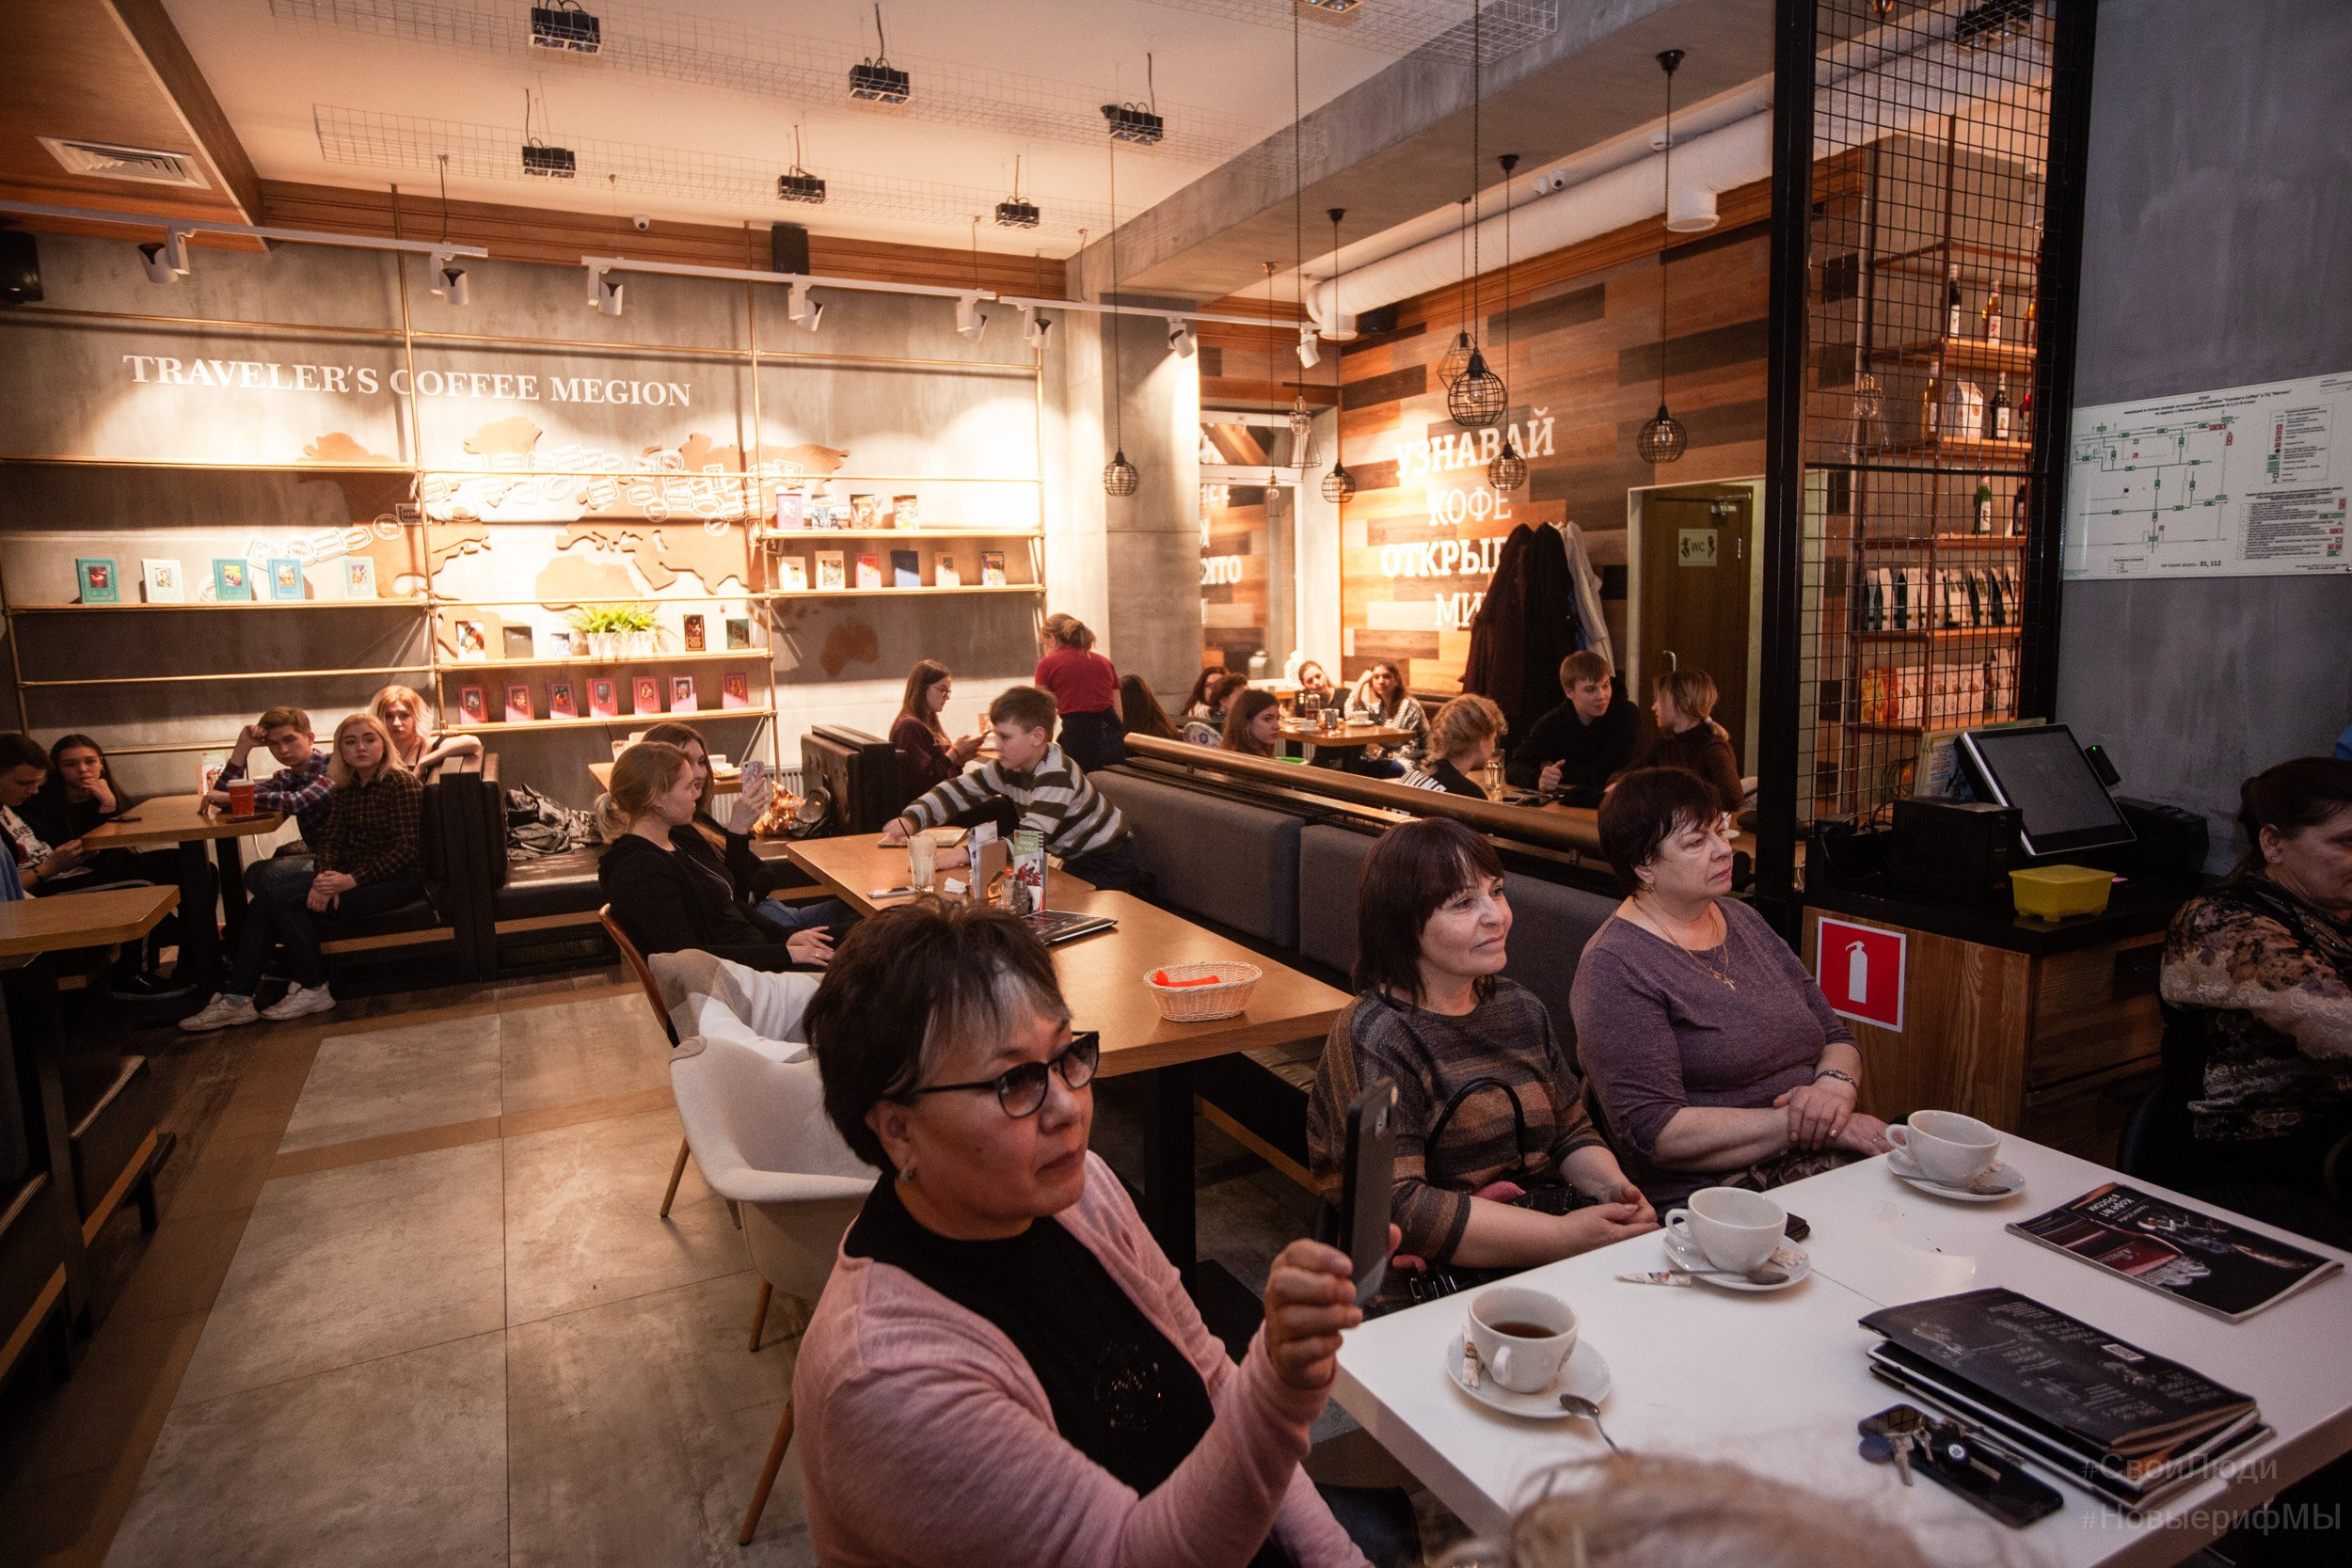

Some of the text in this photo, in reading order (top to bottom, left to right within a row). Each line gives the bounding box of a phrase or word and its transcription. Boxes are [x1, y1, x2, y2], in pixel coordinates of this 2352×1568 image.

[122, 355, 691, 406] TRAVELER'S COFFEE MEGION
[1393, 406, 1555, 477] УЗНАВАЙ
[1428, 484, 1512, 527] КОФЕ
[1691, 542, 1705, 552] WC
[1435, 592, 1487, 627] МИ
